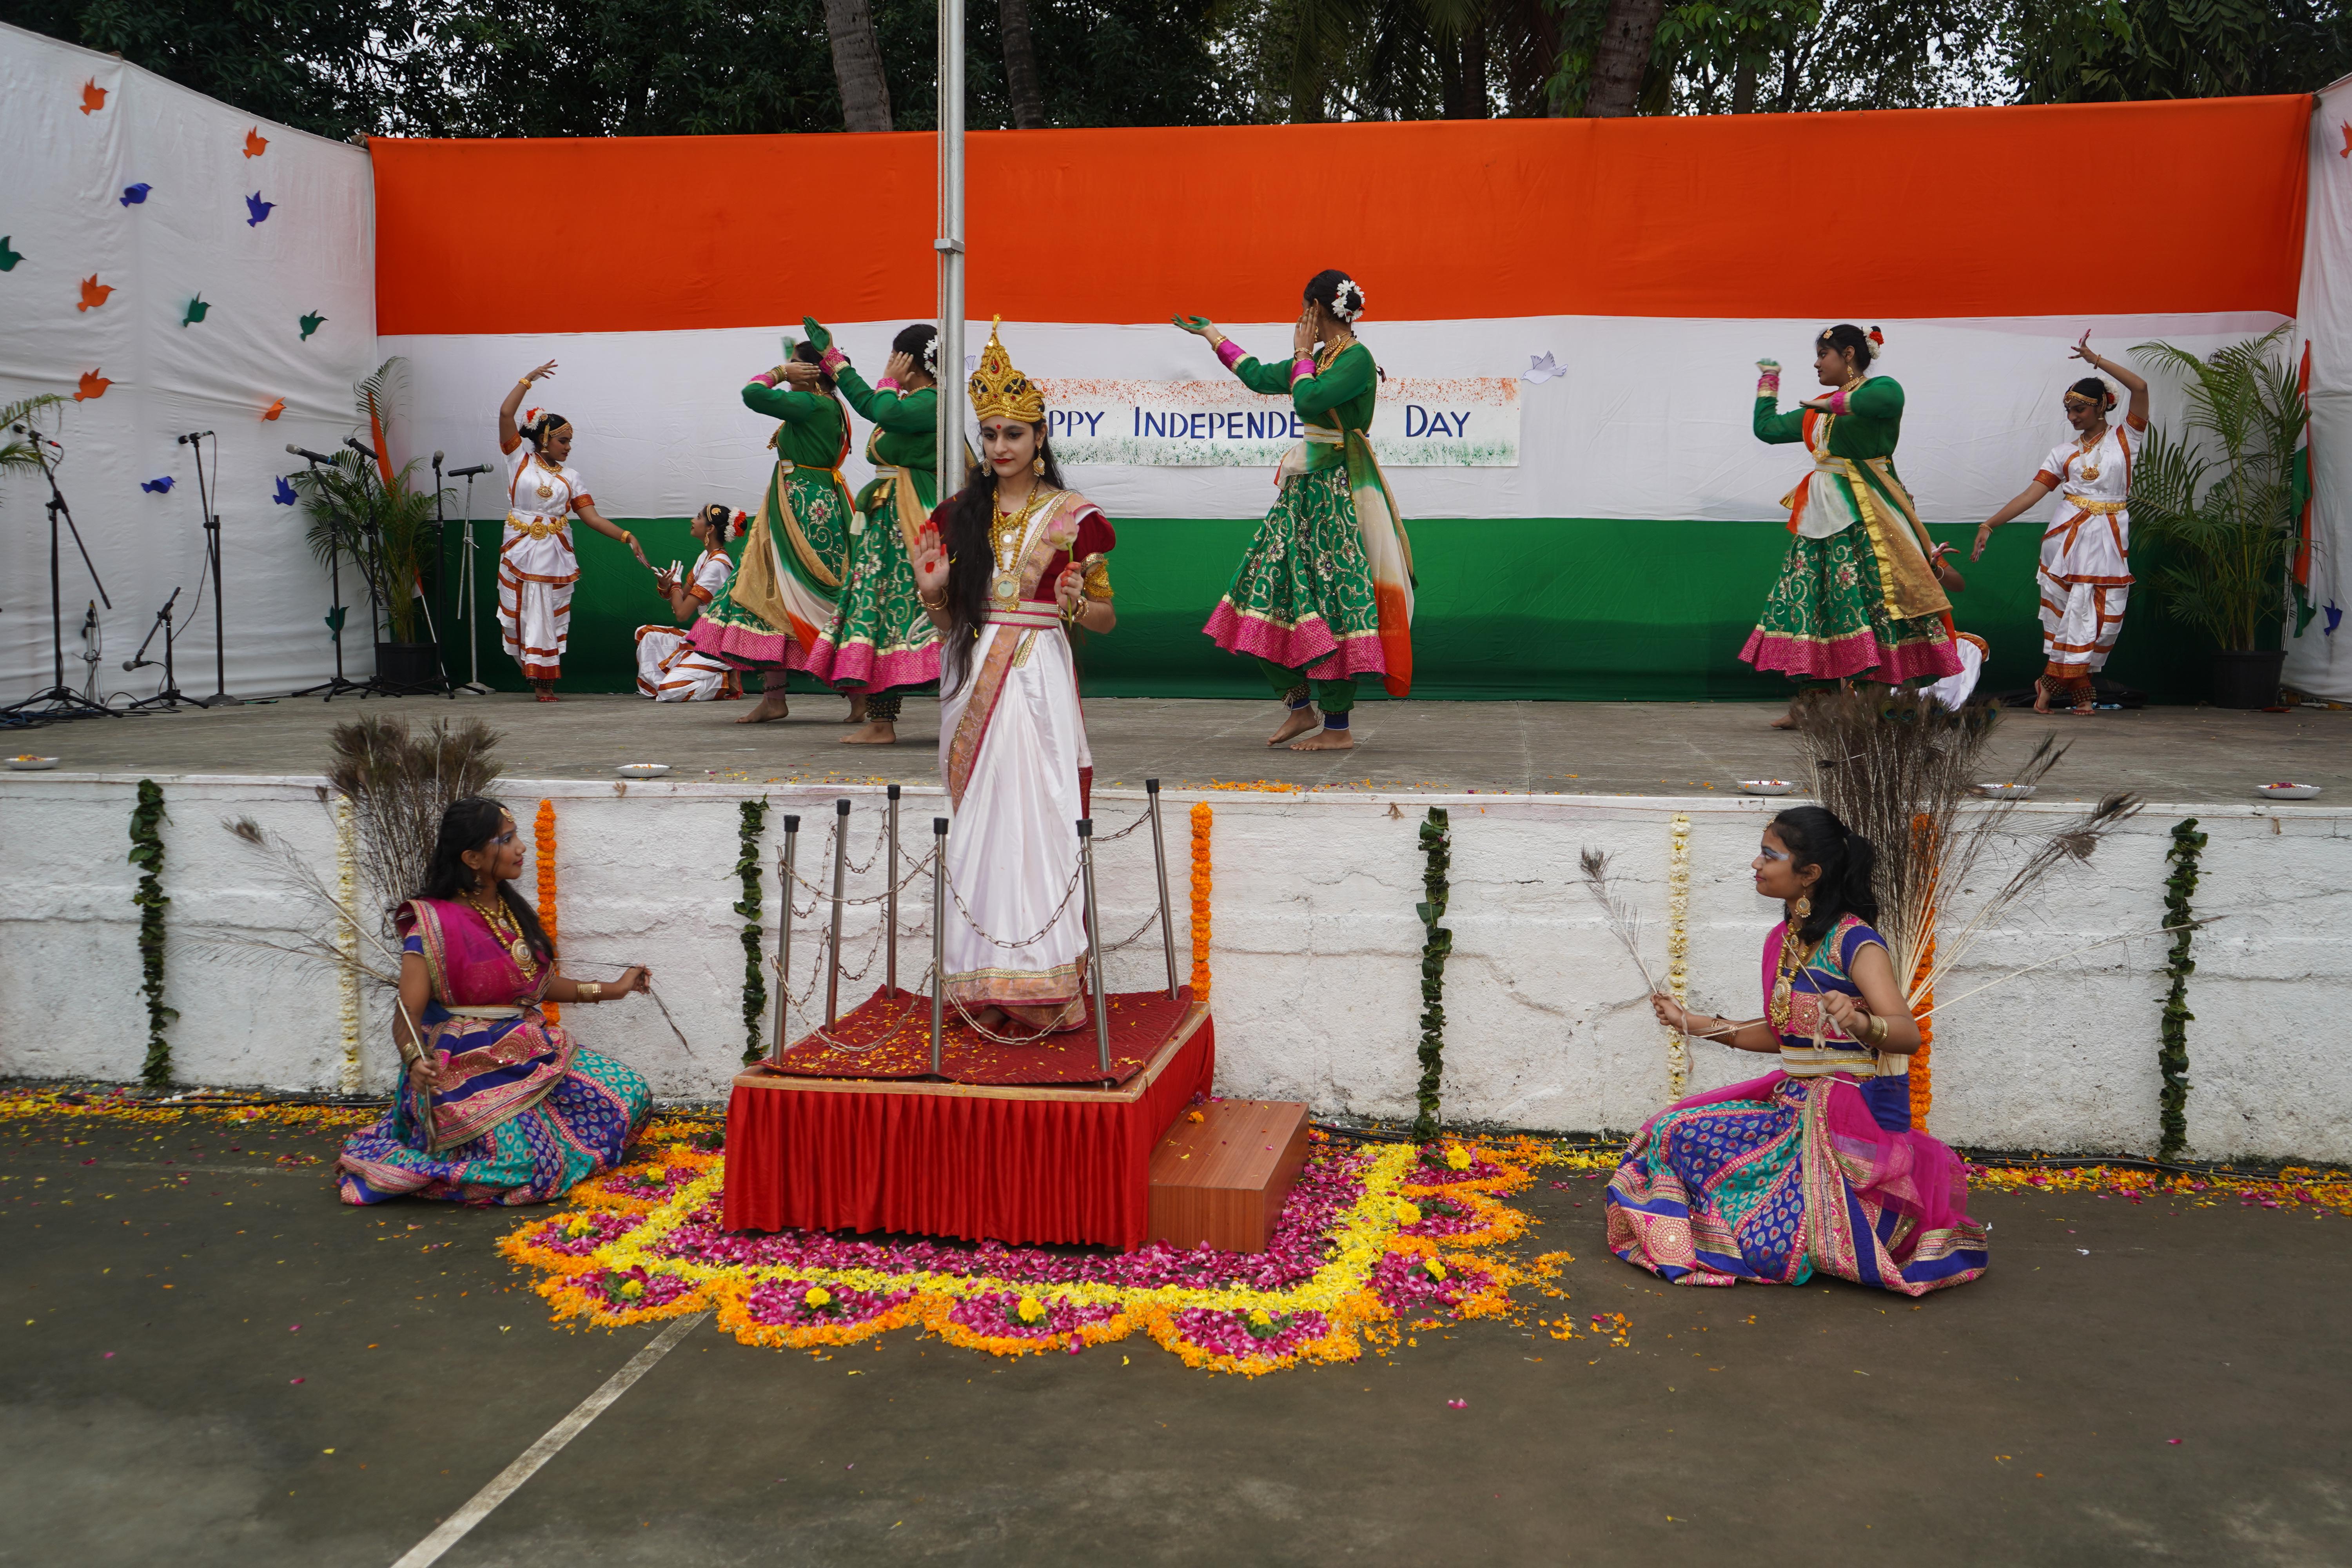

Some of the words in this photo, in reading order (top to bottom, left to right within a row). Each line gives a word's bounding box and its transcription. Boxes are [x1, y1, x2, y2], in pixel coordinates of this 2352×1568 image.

[1049, 410, 1105, 437] PPY
[1135, 407, 1370, 439] INDEPENDE
[1406, 405, 1471, 437] DAY
